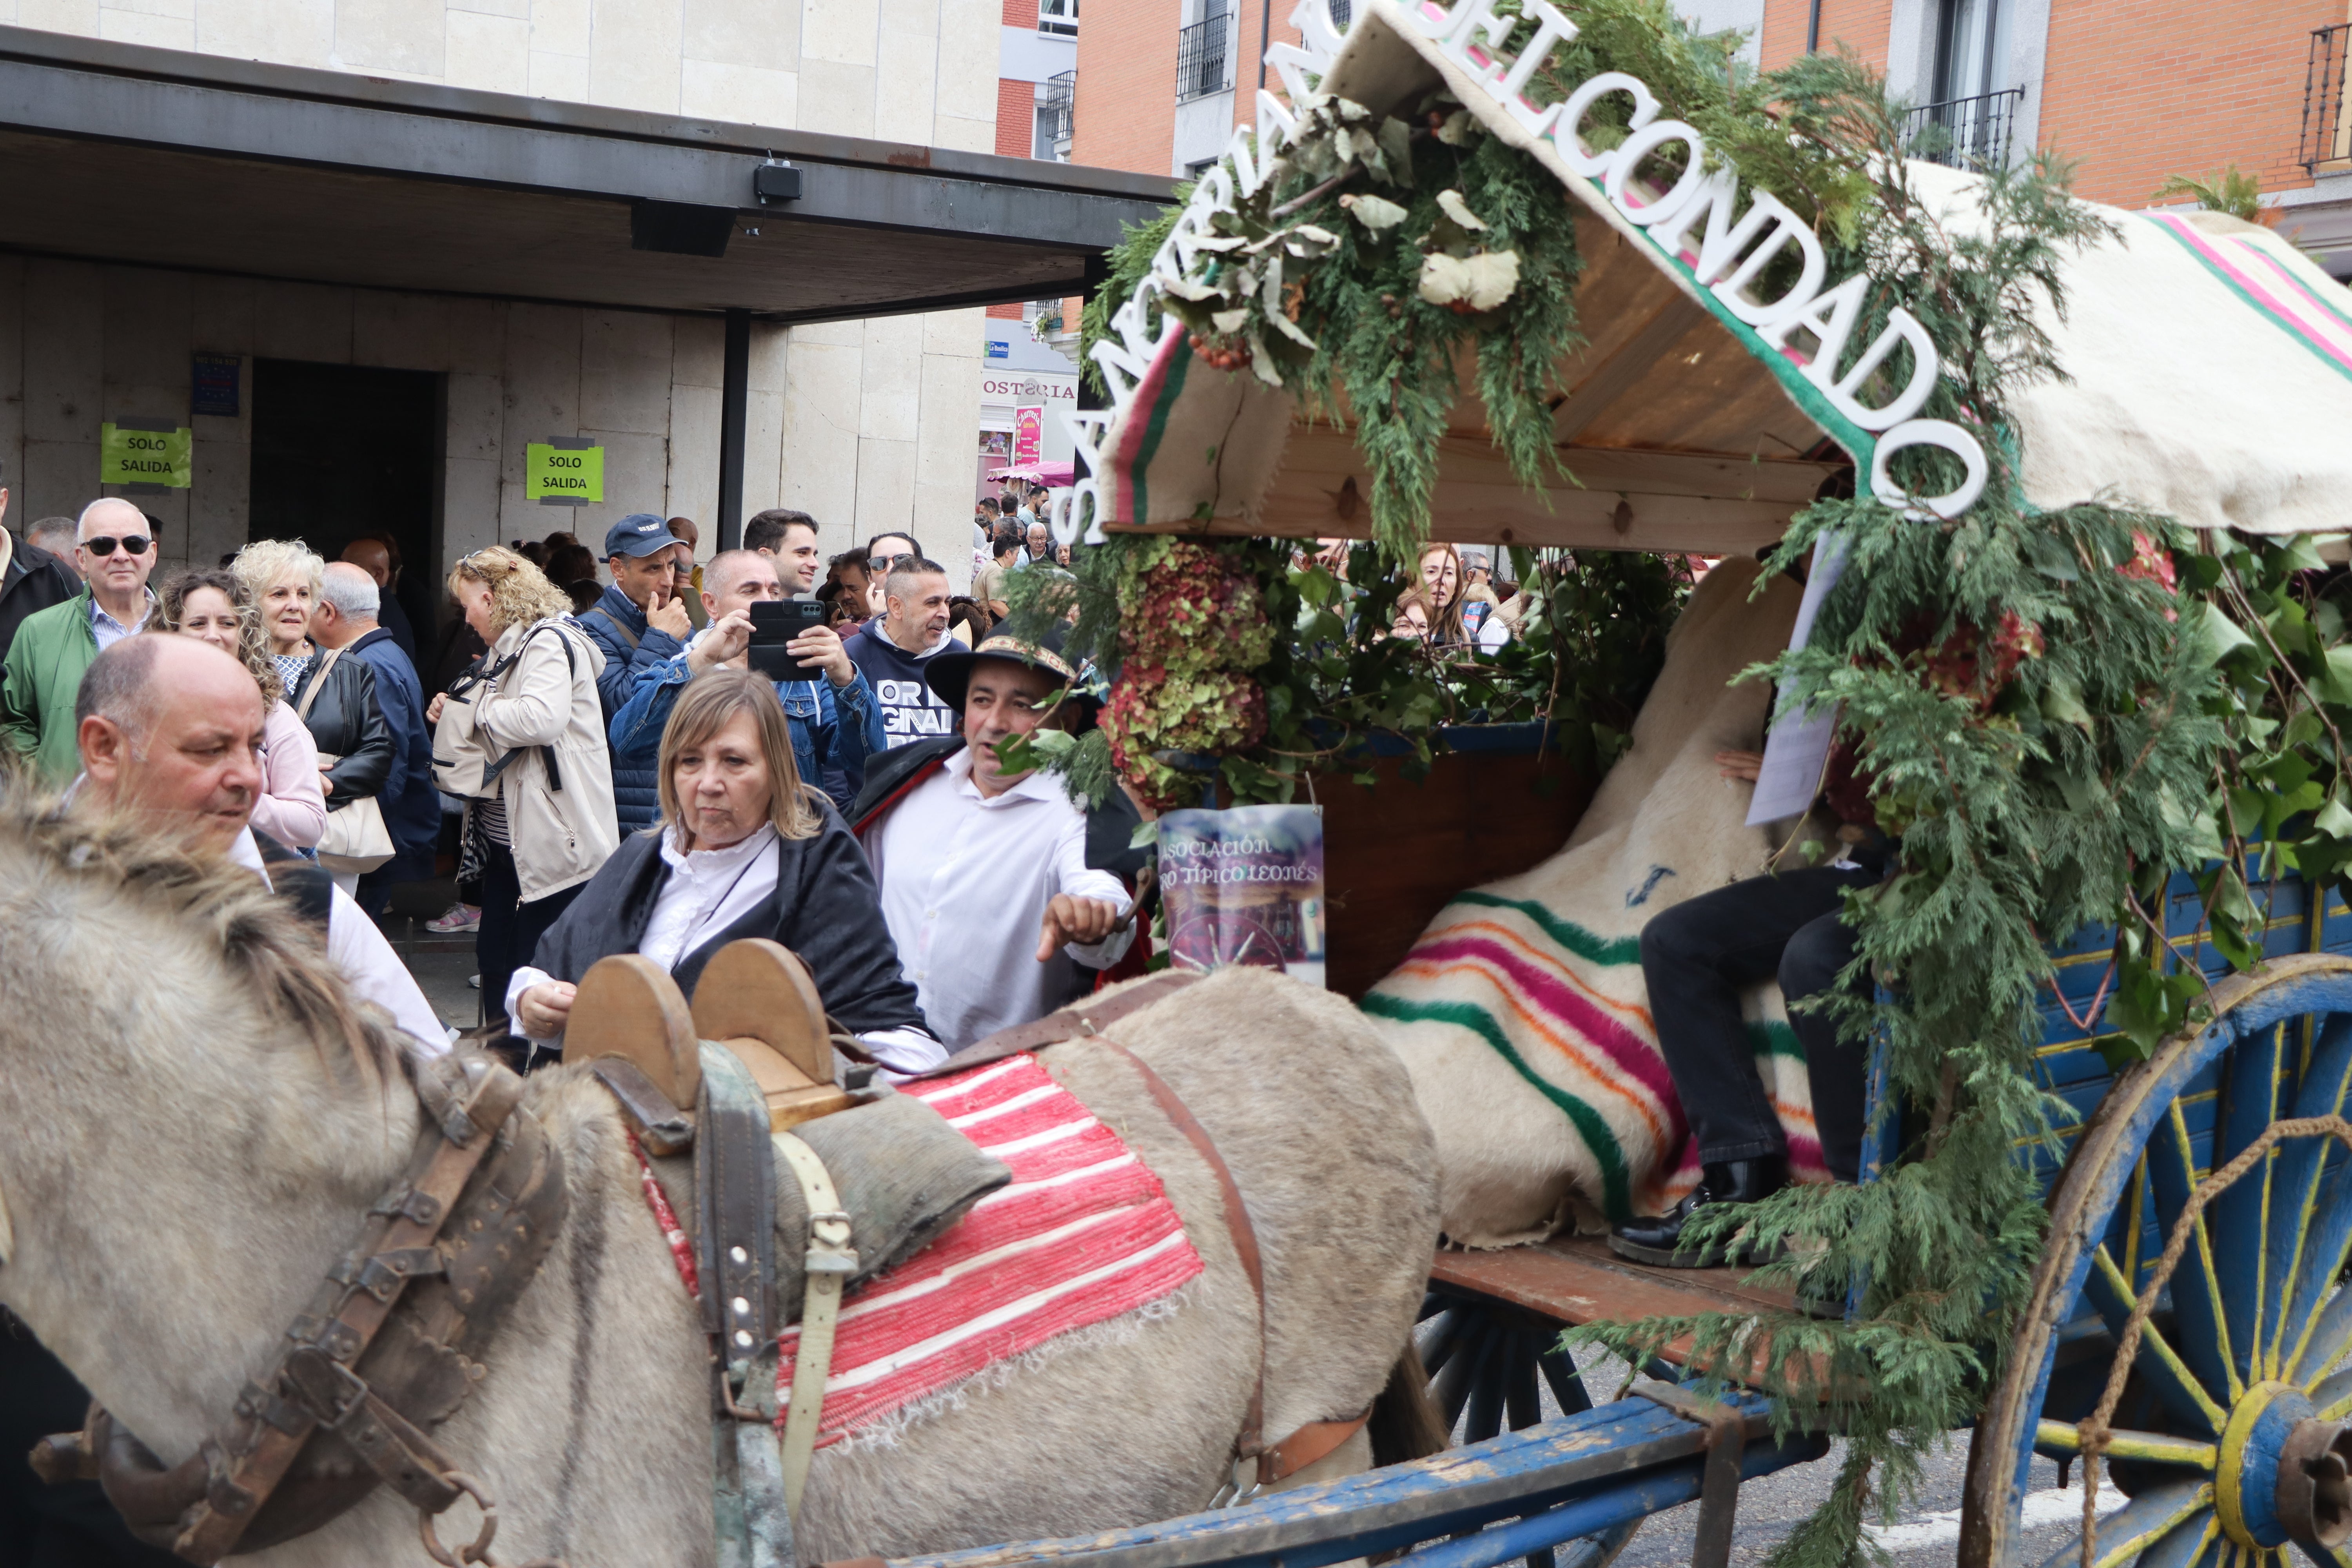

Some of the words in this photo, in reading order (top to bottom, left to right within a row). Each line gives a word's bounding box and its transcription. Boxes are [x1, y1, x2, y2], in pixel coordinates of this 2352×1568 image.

[1554, 72, 1988, 522] CONDADO
[1051, 301, 1149, 545] SAN
[128, 437, 166, 451] SOLO
[121, 459, 172, 474] SALIDA
[549, 456, 581, 468] SOLO
[543, 477, 587, 489] SALIDA
[908, 711, 920, 728] PRIVATA
[1180, 863, 1246, 884] TÍPICO
[1247, 860, 1318, 882] LEONÉS
